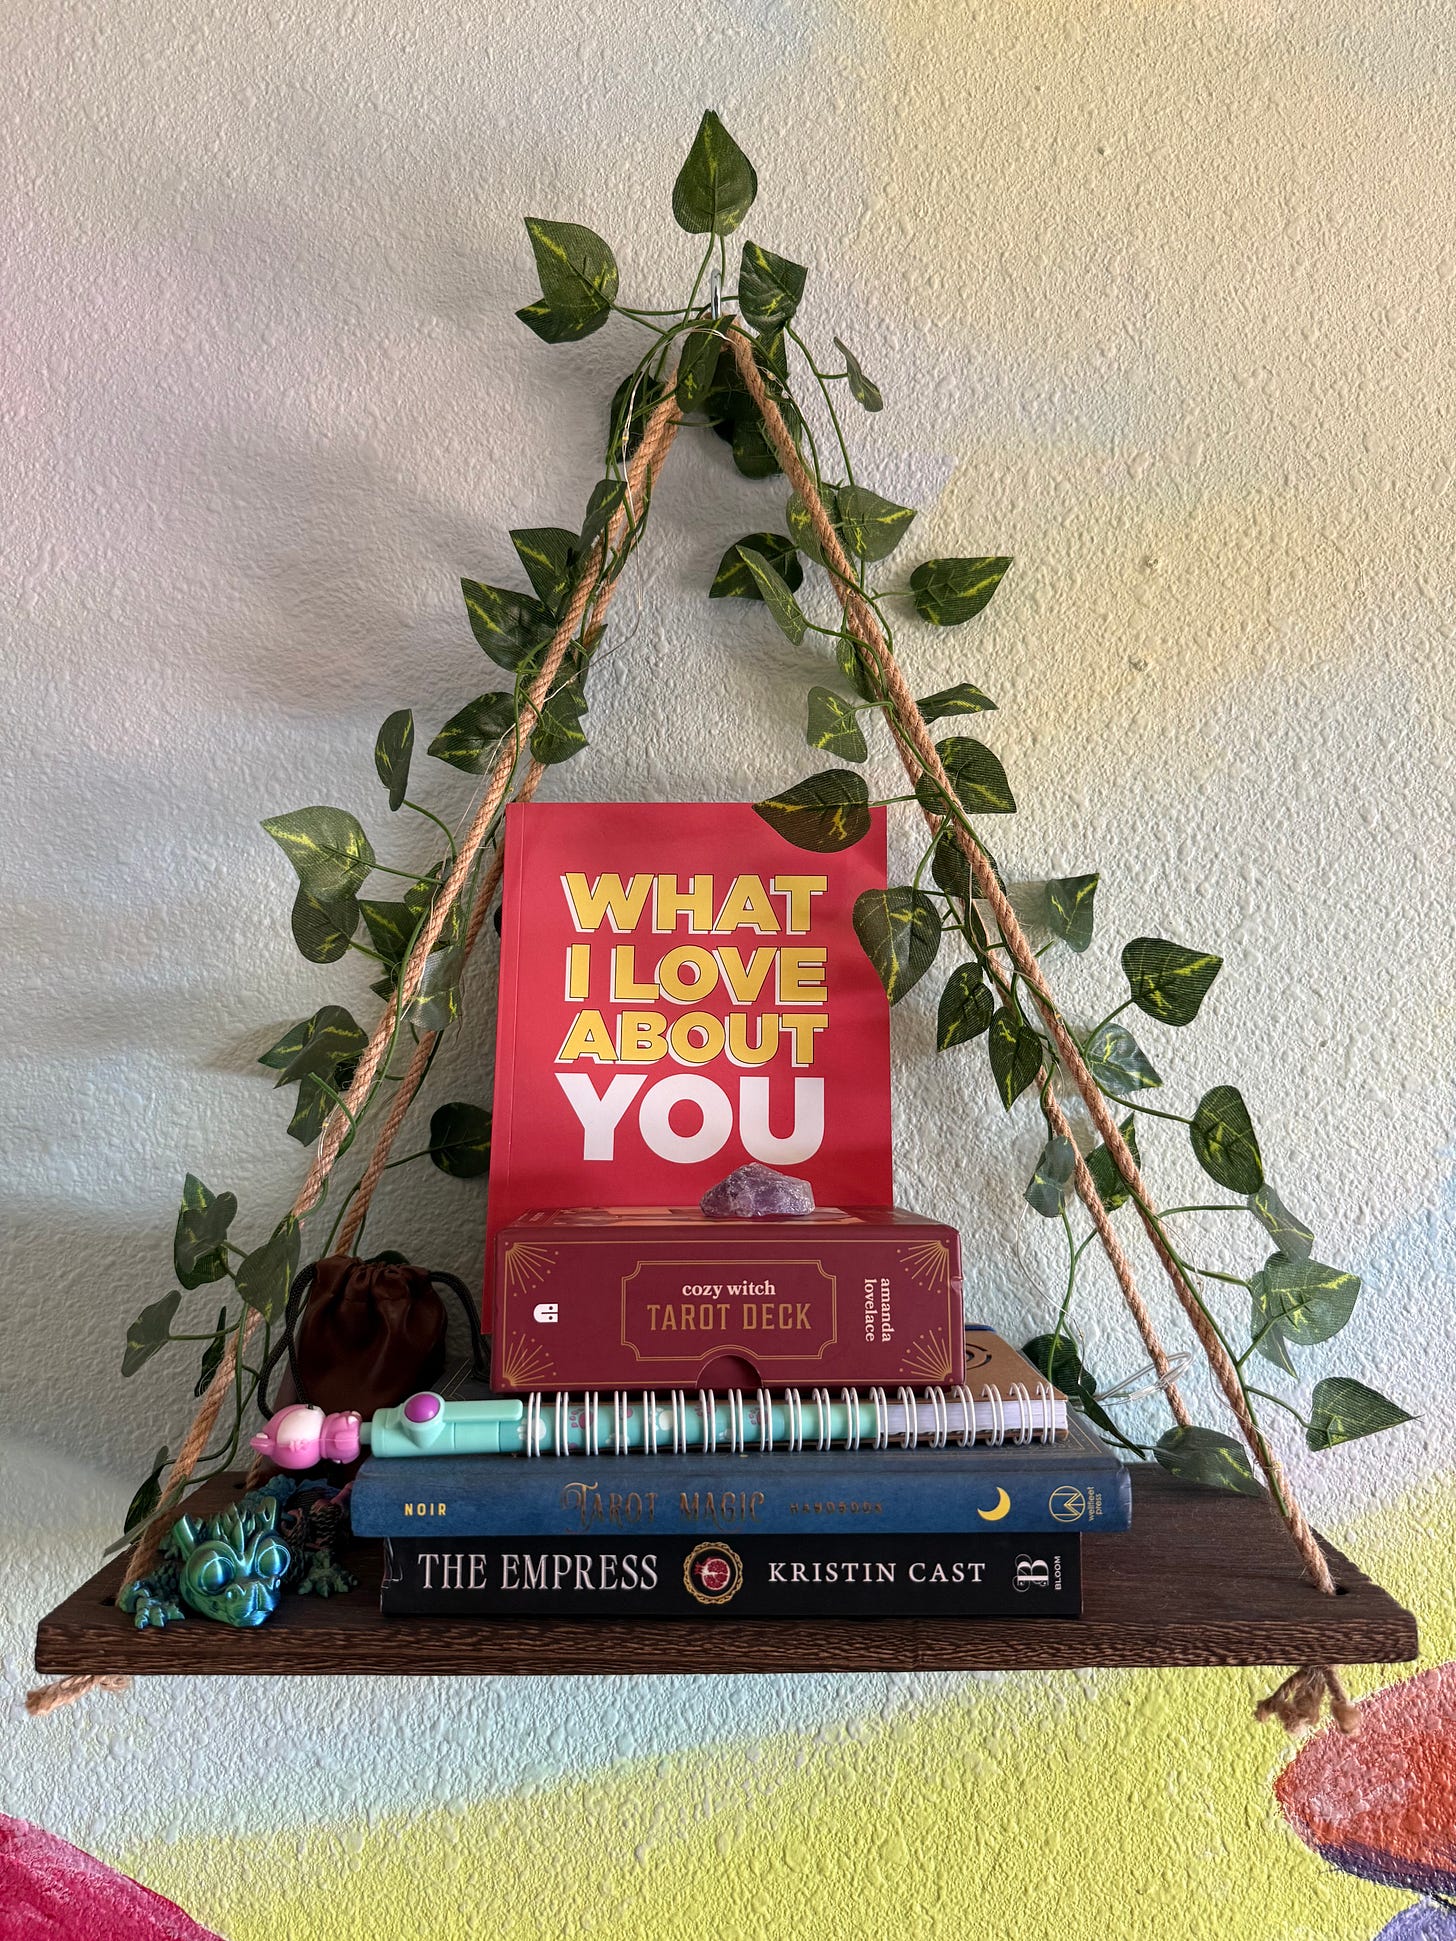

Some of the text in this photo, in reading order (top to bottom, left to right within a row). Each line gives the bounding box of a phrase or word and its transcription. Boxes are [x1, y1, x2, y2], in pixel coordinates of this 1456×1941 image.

[560, 872, 829, 935] WHAT
[565, 944, 829, 1006] I LOVE
[554, 1009, 829, 1068] ABOUT
[554, 1073, 825, 1165] YOU
[682, 1280, 776, 1300] cozy witch
[647, 1303, 812, 1331] TAROT DECK
[864, 1278, 878, 1342] lovelace
[880, 1278, 895, 1342] amanda
[404, 1502, 448, 1517] NOIR
[679, 1491, 765, 1533] MAGIC
[1096, 1493, 1104, 1515] press
[418, 1553, 659, 1590] THE EMPRESS
[768, 1561, 986, 1583] KRISTIN CAST
[1053, 1555, 1062, 1591] BLOOM
